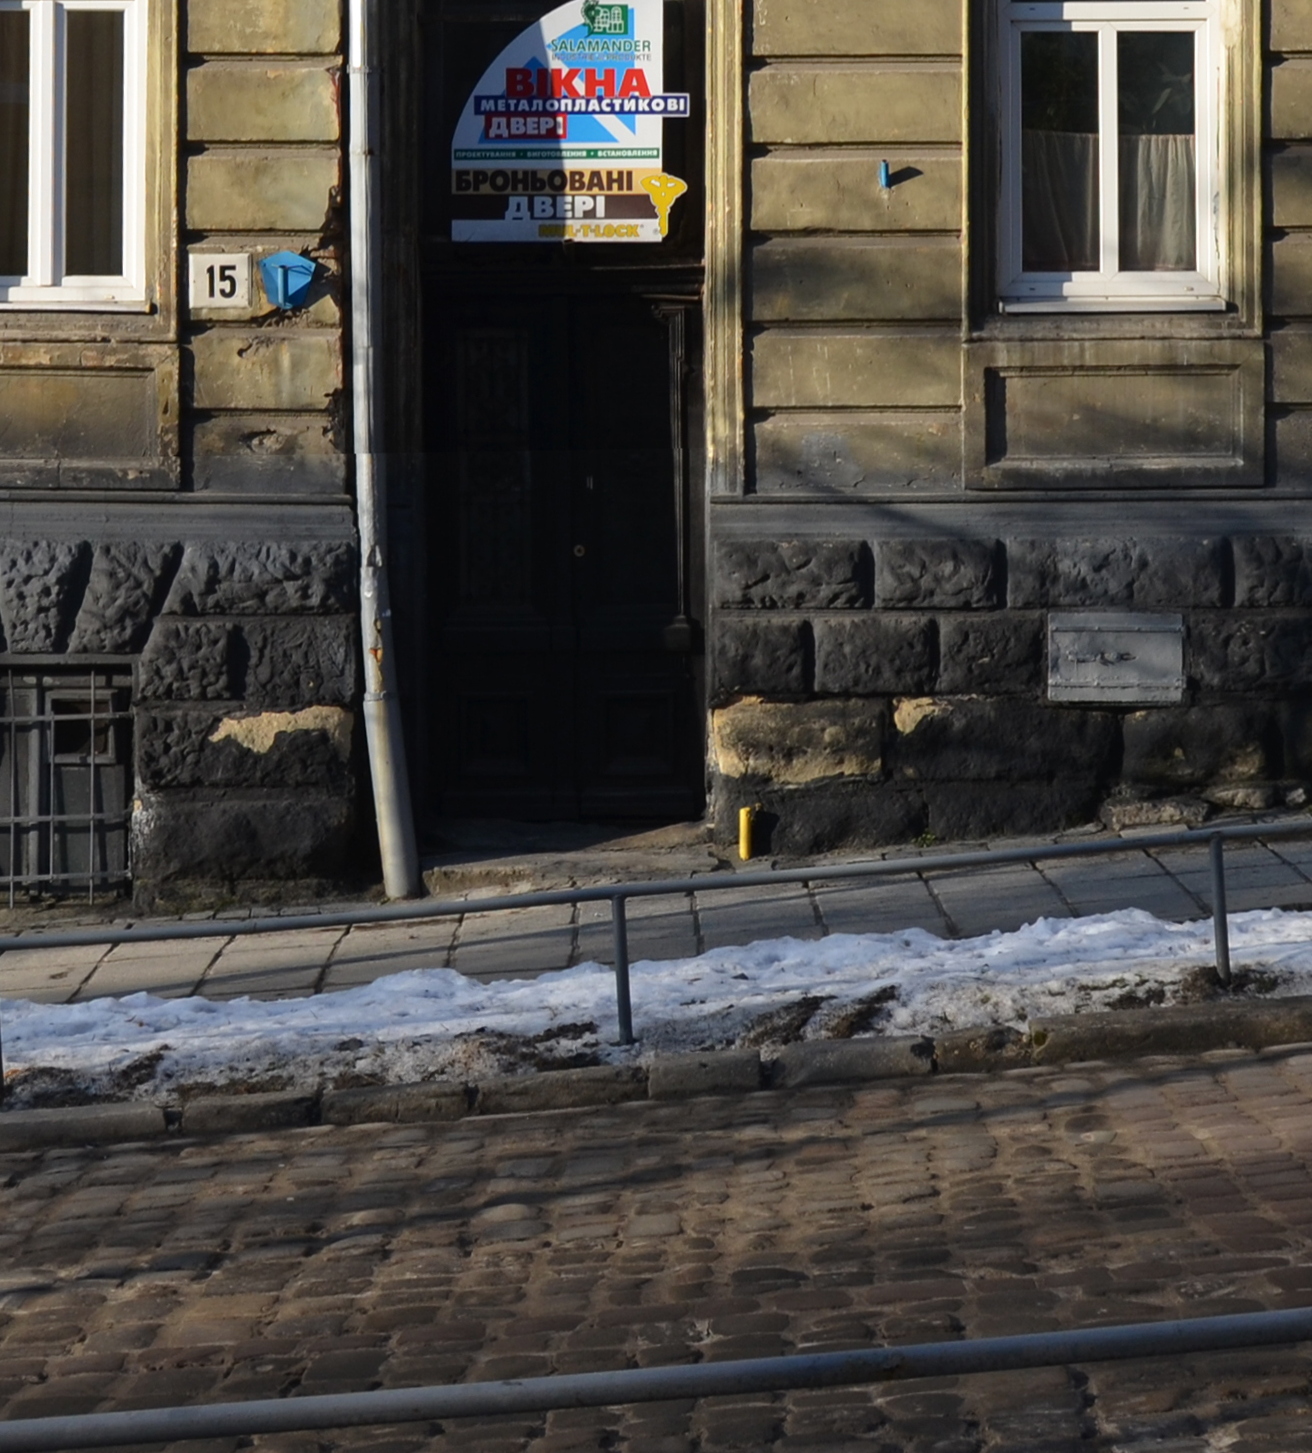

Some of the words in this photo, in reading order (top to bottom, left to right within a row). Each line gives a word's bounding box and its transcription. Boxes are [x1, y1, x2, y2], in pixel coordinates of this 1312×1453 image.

[550, 38, 652, 53] SALAMANDER
[504, 67, 652, 99] ВІКНА
[480, 98, 686, 112] МЕТАЛОПЛАСТИКОВІ
[488, 116, 564, 139] ДВЕРІ
[596, 148, 659, 158] ВСТАНОВЛЕННЯ
[455, 170, 634, 193] БРОНЬОВАНІ
[504, 195, 606, 220] ДВЕРІ
[206, 264, 237, 299] 15
